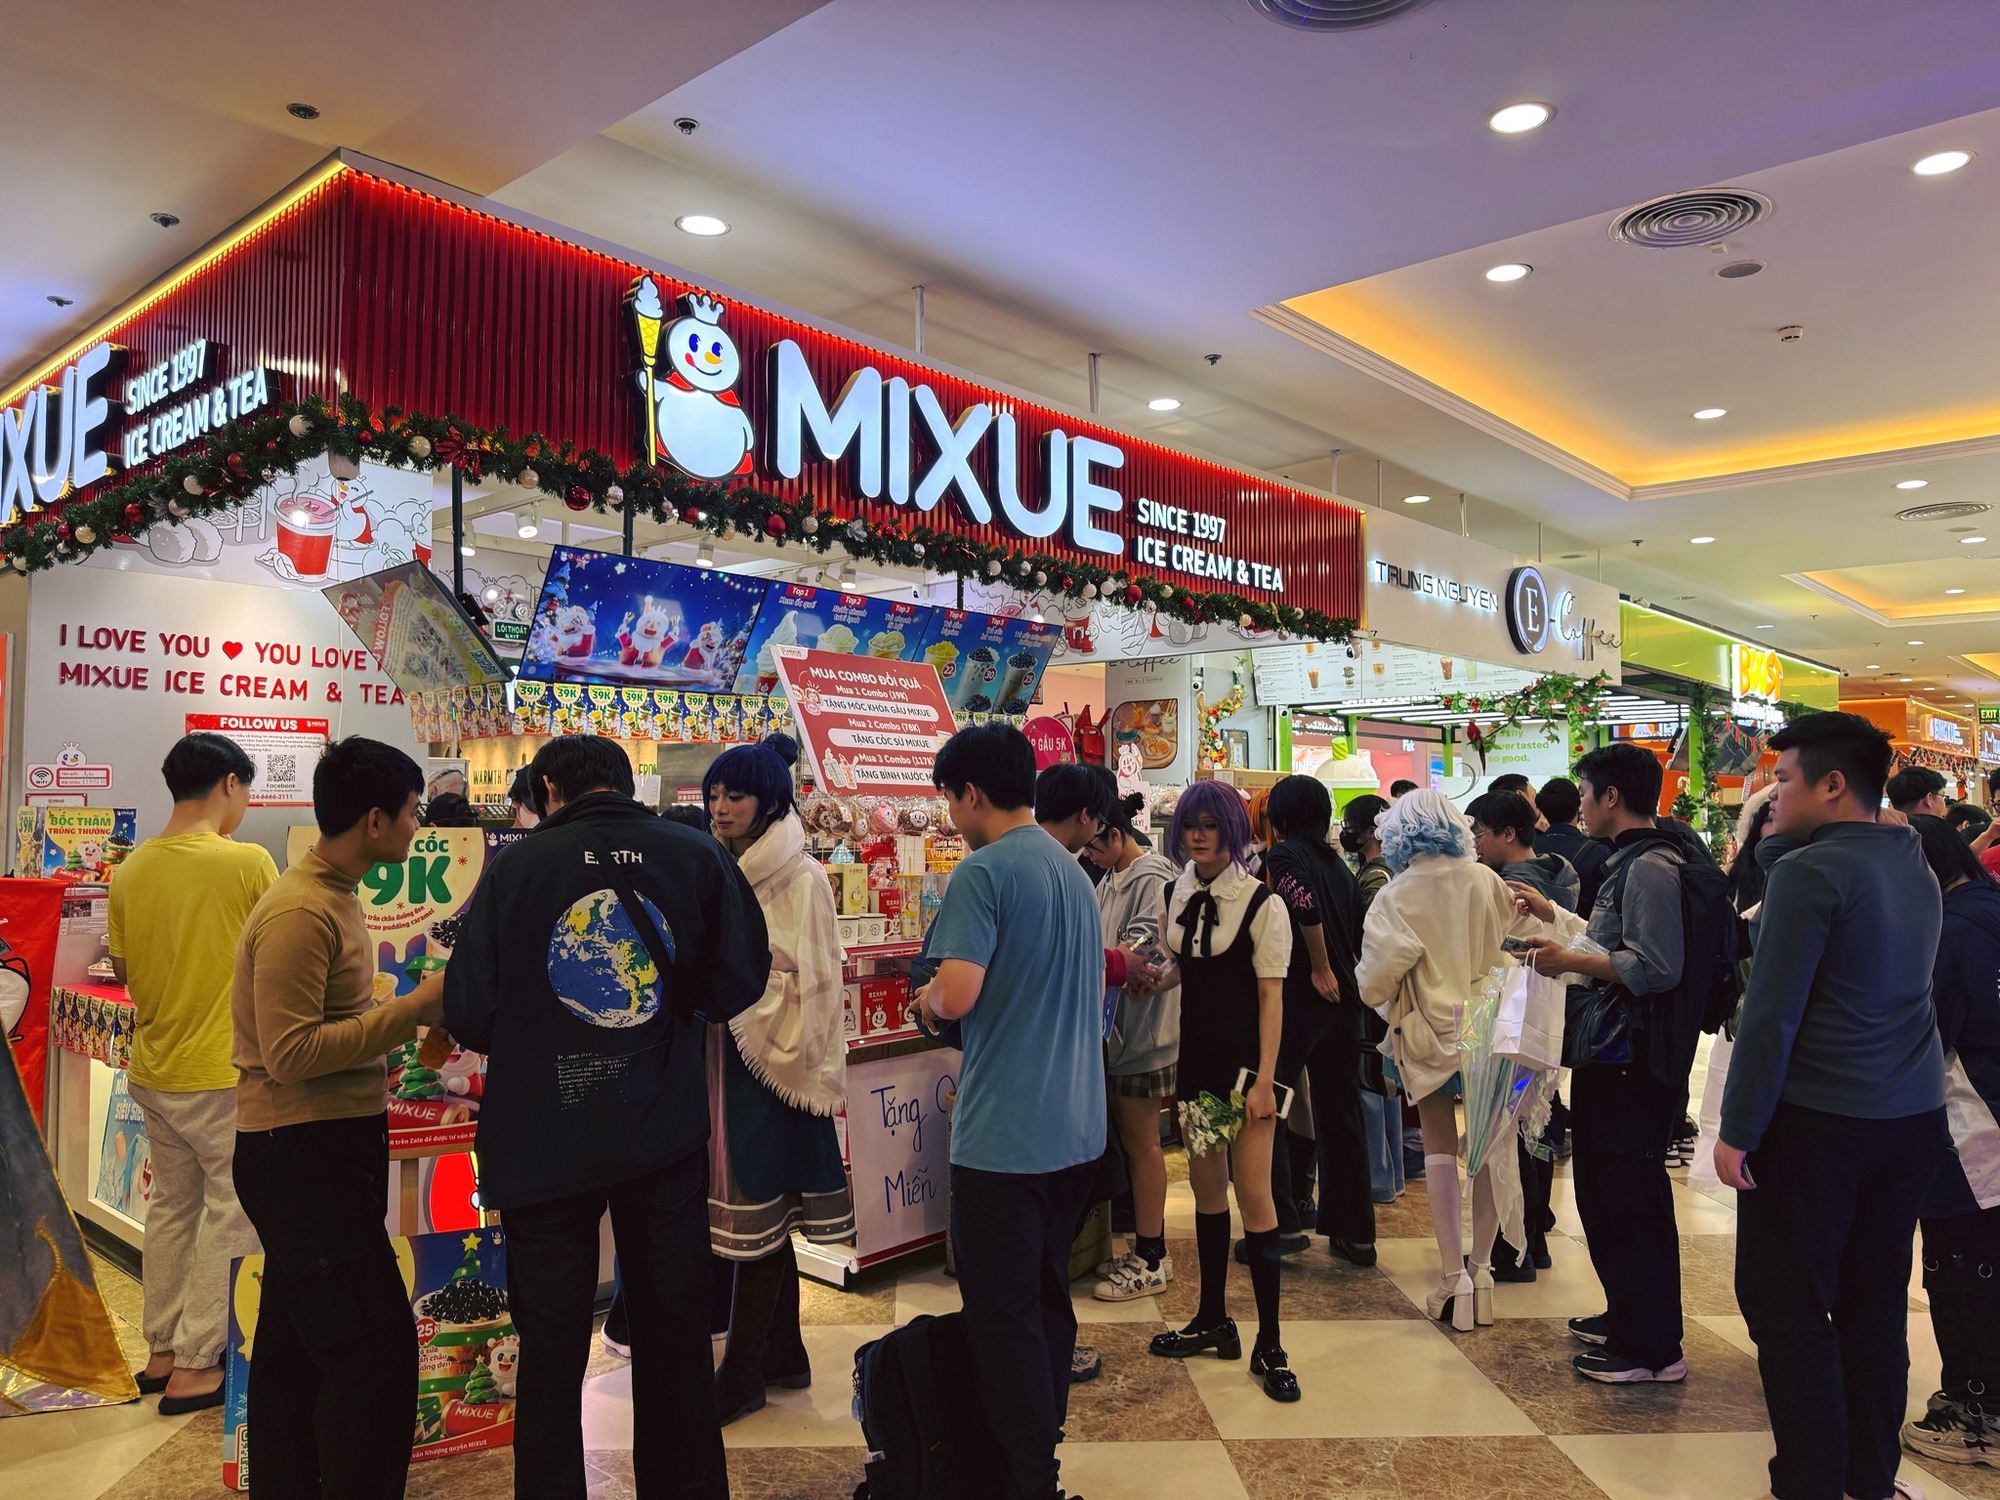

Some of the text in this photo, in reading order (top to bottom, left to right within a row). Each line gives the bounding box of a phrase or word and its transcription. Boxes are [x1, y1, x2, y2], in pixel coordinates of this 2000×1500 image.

[126, 338, 206, 415] SINCE 1997
[124, 365, 268, 469] ICE CREAM & TEA
[777, 339, 1124, 555] MIXUE
[1137, 497, 1226, 543] SINCE 1997
[1137, 535, 1283, 592] ICE CREAM & TEA
[791, 586, 809, 597] Top 1
[1376, 561, 1498, 612] TRUNG NGUYEN
[845, 596, 857, 606] Top
[895, 604, 906, 614] Top
[991, 616, 1000, 625] Top
[59, 623, 67, 647] I
[78, 625, 147, 653] LOVE
[159, 633, 210, 658] YOU
[255, 642, 301, 666] YOU
[311, 646, 368, 670] LOVE
[809, 666, 837, 681] MUA
[839, 670, 877, 685] COMBO
[943, 666, 954, 675] 22
[985, 671, 995, 679] 30
[59, 662, 148, 690] MIXUE
[164, 670, 205, 694] ICE
[219, 674, 308, 701] CREAM
[327, 682, 342, 702] &
[359, 683, 405, 705] TEA
[1024, 674, 1034, 682] 25
[489, 686, 502, 697] 39K
[520, 686, 541, 696] 39K
[558, 689, 577, 698] 39K
[593, 690, 611, 700] 39K
[626, 692, 643, 701] 39K
[835, 685, 909, 702] Mua 1 Combo (39K)
[657, 694, 674, 704] 39K
[688, 697, 703, 706] 39K
[716, 698, 731, 707] 39K
[744, 700, 759, 709] 39K
[771, 701, 786, 710] 39K
[823, 699, 931, 717] TẶNG MÓC KHÓA GẤU MIXUE
[1981, 709, 1997, 719] EXIT
[220, 717, 298, 731] FOLLOW US
[848, 718, 921, 734] Mua 2 Combo (78K)
[851, 734, 931, 749] TẶNG CỐC SỨ MIXUE
[1037, 734, 1054, 751] GẤU
[1055, 737, 1067, 751] 5K
[1516, 740, 1549, 750] tasted
[858, 753, 877, 763] Mua
[878, 754, 883, 762] 3
[884, 755, 911, 765] Combo
[1501, 753, 1530, 764] good.
[473, 769, 502, 785] WARMTH
[856, 769, 879, 781] TẶNG
[880, 769, 900, 780] BÌNH
[901, 771, 924, 781] NƯỚC
[19, 816, 34, 833] 39K
[50, 811, 111, 827] BỐC THĂM
[584, 850, 643, 865] ERTH
[352, 855, 452, 906] 9K
[414, 905, 425, 914] đen
[382, 908, 435, 931] pudding caramel
[387, 1101, 438, 1120] MIXUE
[870, 1085, 927, 1152] Tặng
[395, 1137, 409, 1145] trên
[885, 1166, 938, 1213] Miễn
[430, 1353, 448, 1362] châu
[436, 1361, 450, 1370] đen
[455, 1405, 495, 1419] MIXUE
[468, 1438, 488, 1448] MIXUE
